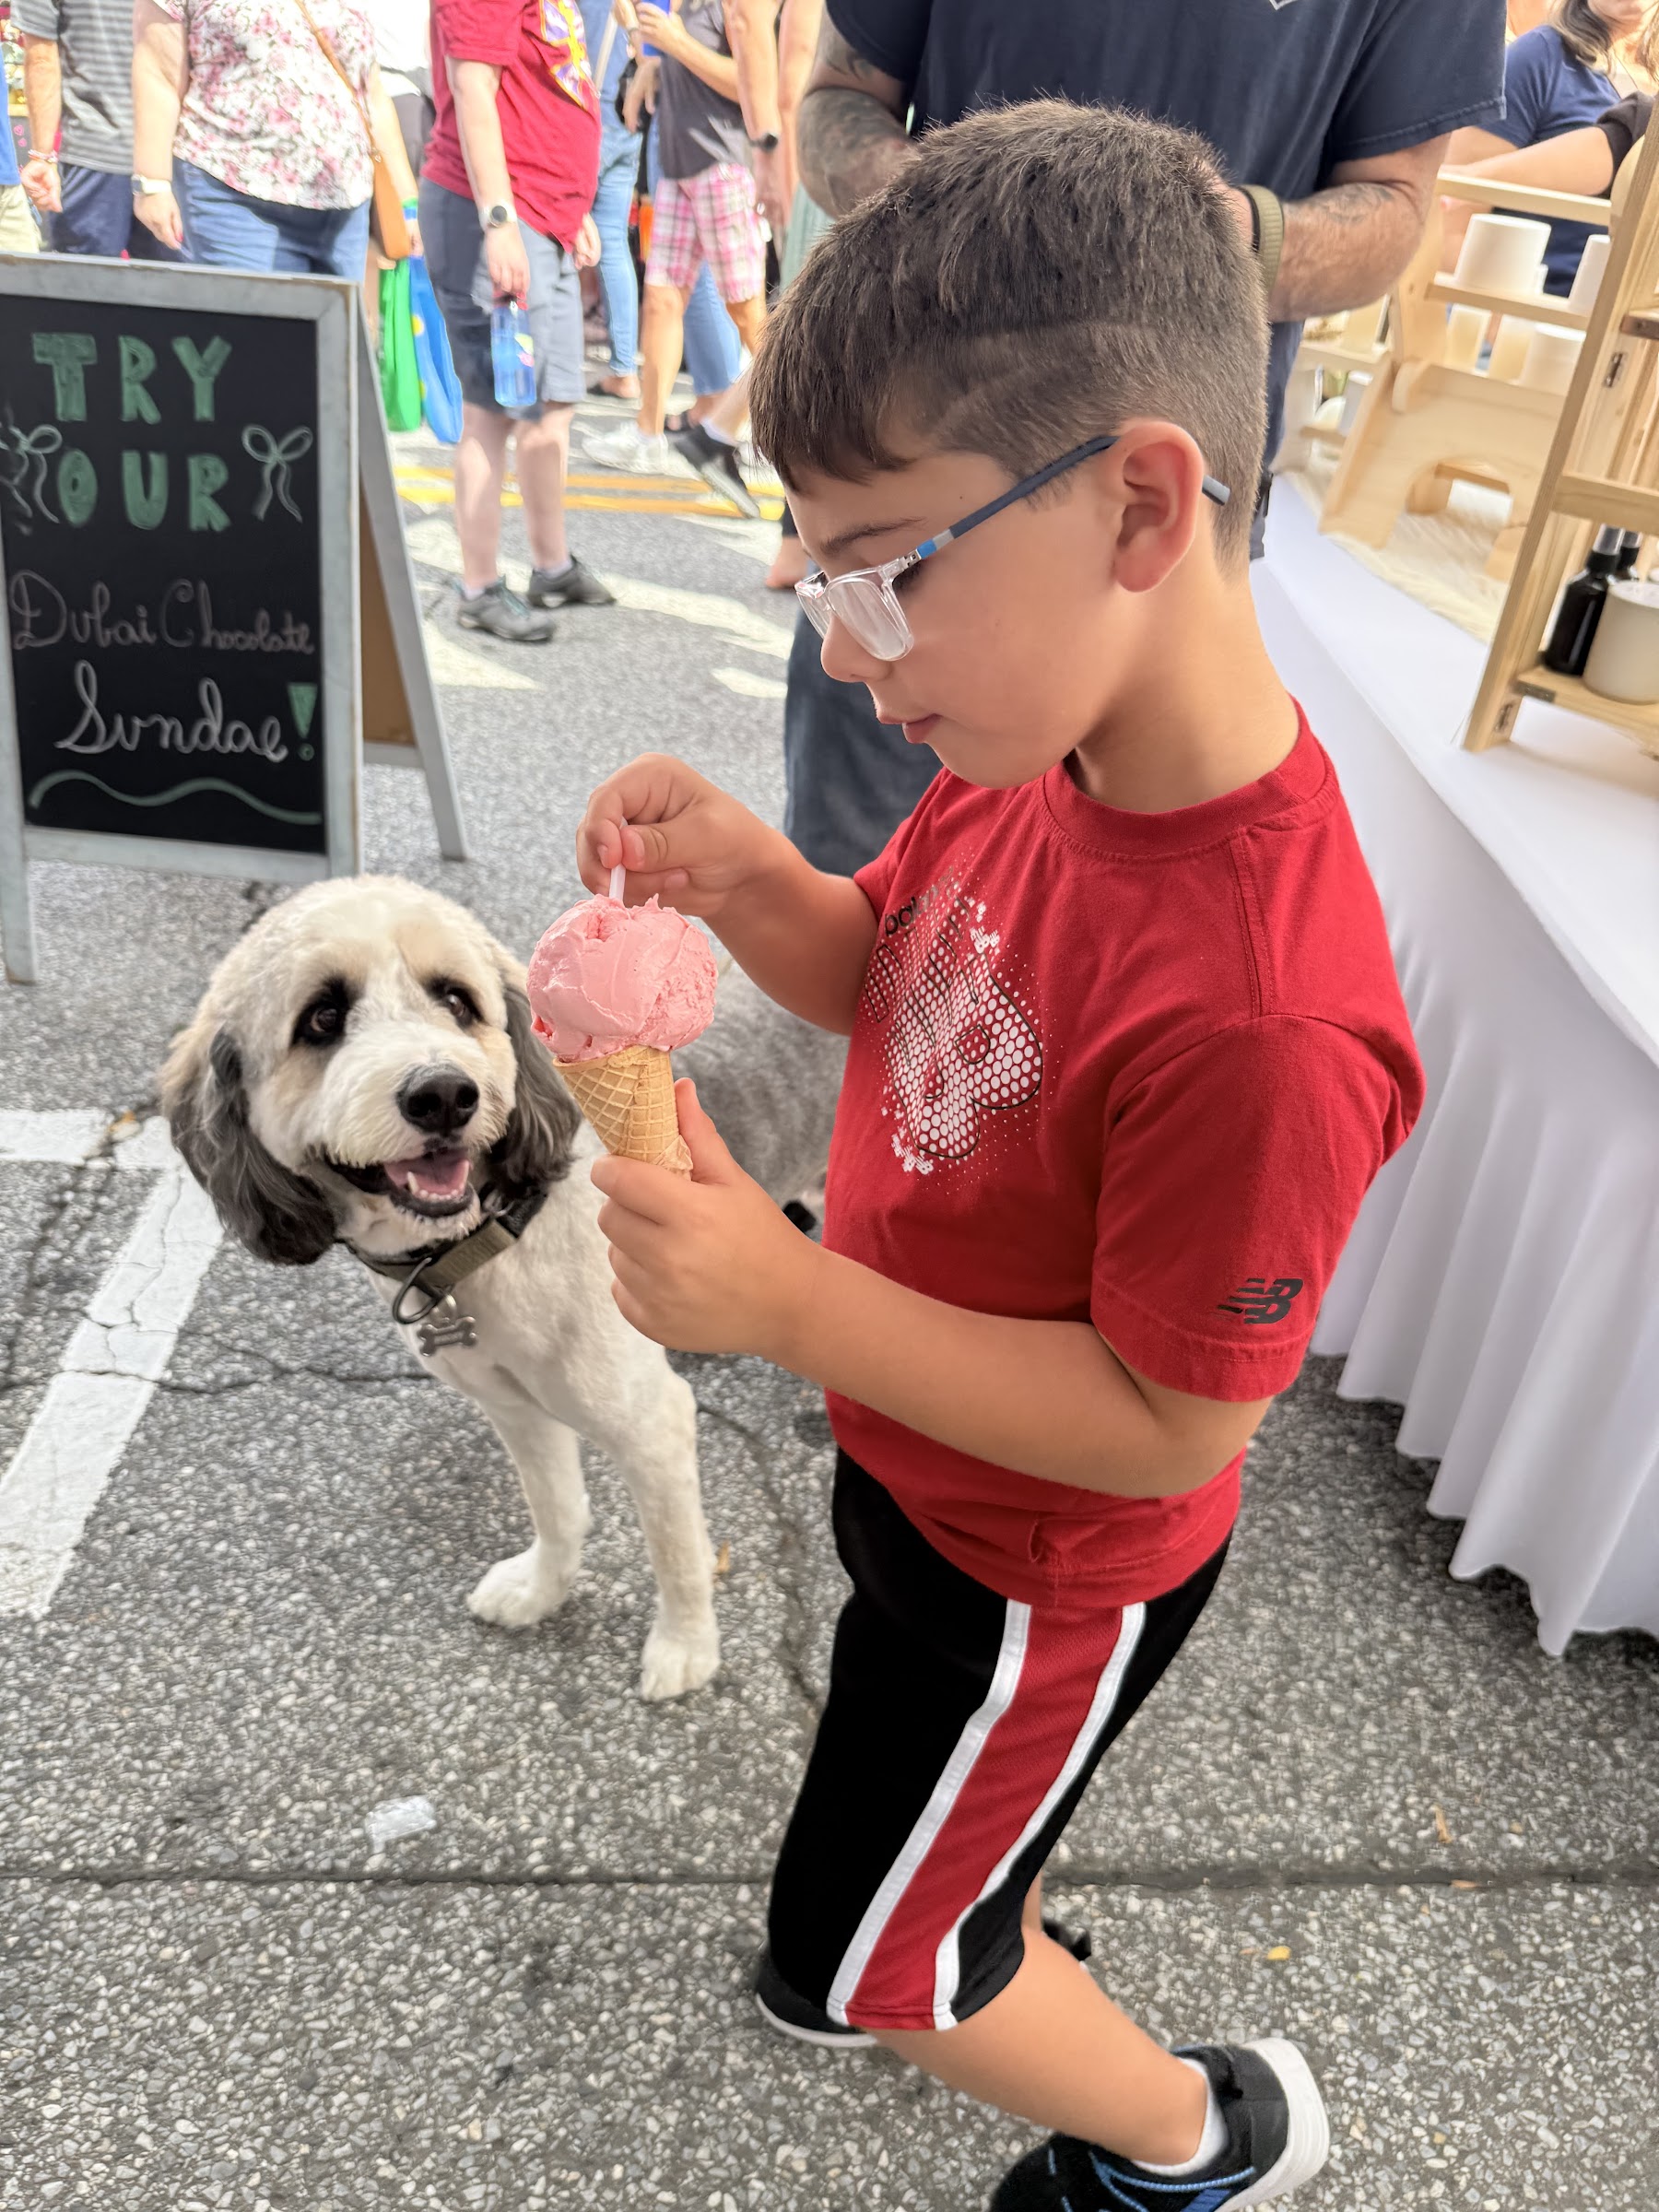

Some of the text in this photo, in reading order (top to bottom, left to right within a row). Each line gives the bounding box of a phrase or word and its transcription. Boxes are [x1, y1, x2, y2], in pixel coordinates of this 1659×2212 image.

[32, 332, 232, 425] TRY
[57, 448, 231, 532] OUR
[10, 570, 315, 654] Dubai Chocolate
